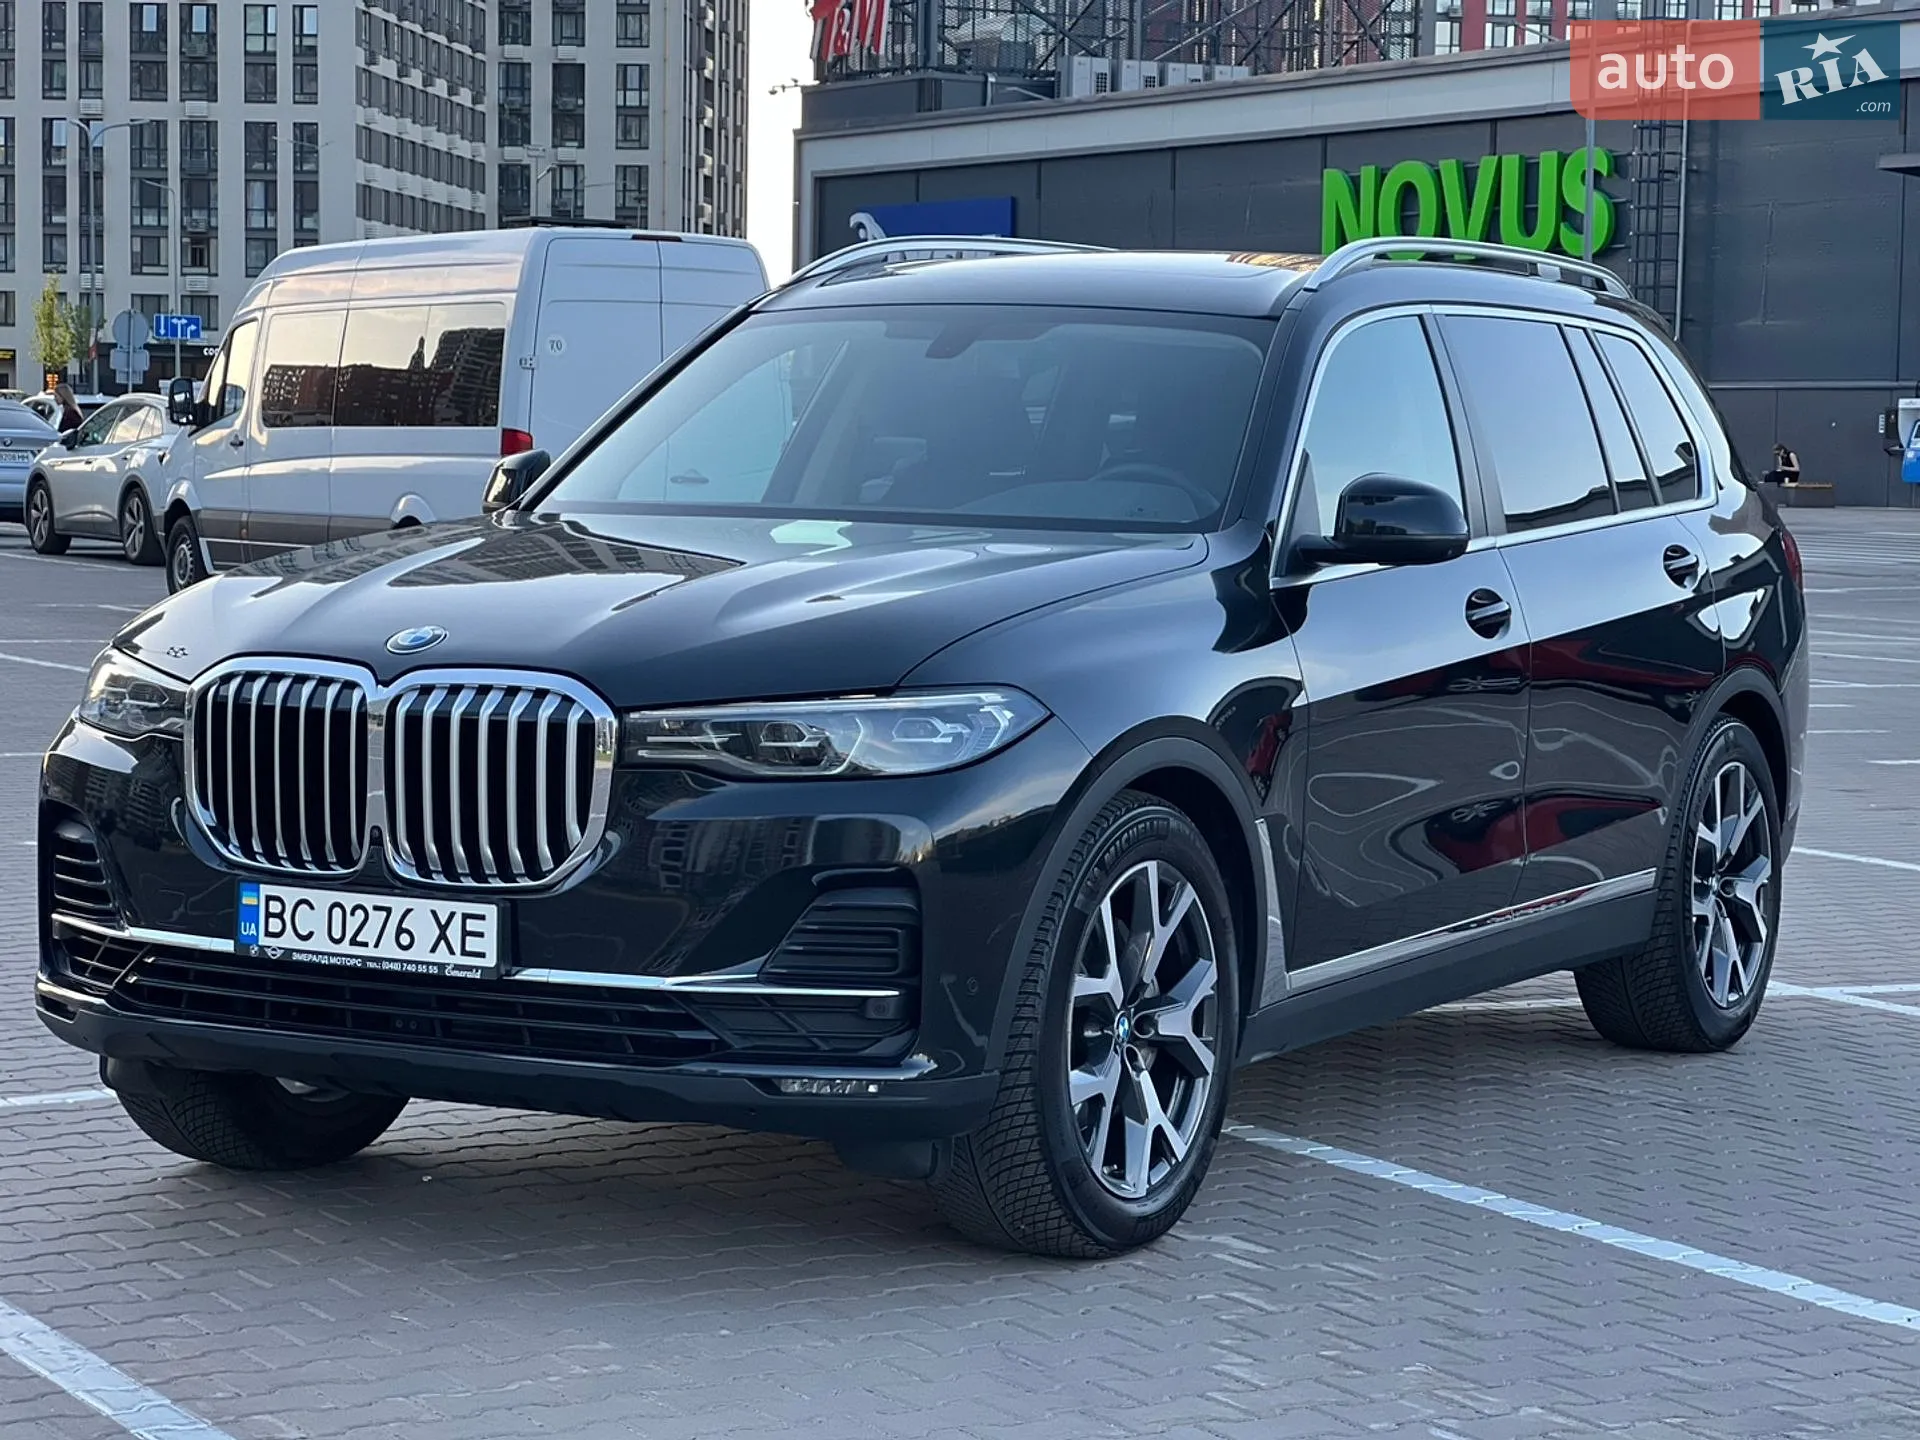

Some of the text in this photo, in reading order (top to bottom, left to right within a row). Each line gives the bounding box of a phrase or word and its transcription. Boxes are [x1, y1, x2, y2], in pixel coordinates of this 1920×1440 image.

[1322, 146, 1616, 260] NOVUS
[241, 921, 258, 937] UA
[264, 894, 487, 959] BC 0276 XE
[291, 951, 329, 965] ЭМЕРАЛД
[329, 955, 362, 967] МОТОРС
[402, 962, 417, 972] 740
[418, 964, 427, 973] 55
[428, 965, 439, 974] 55
